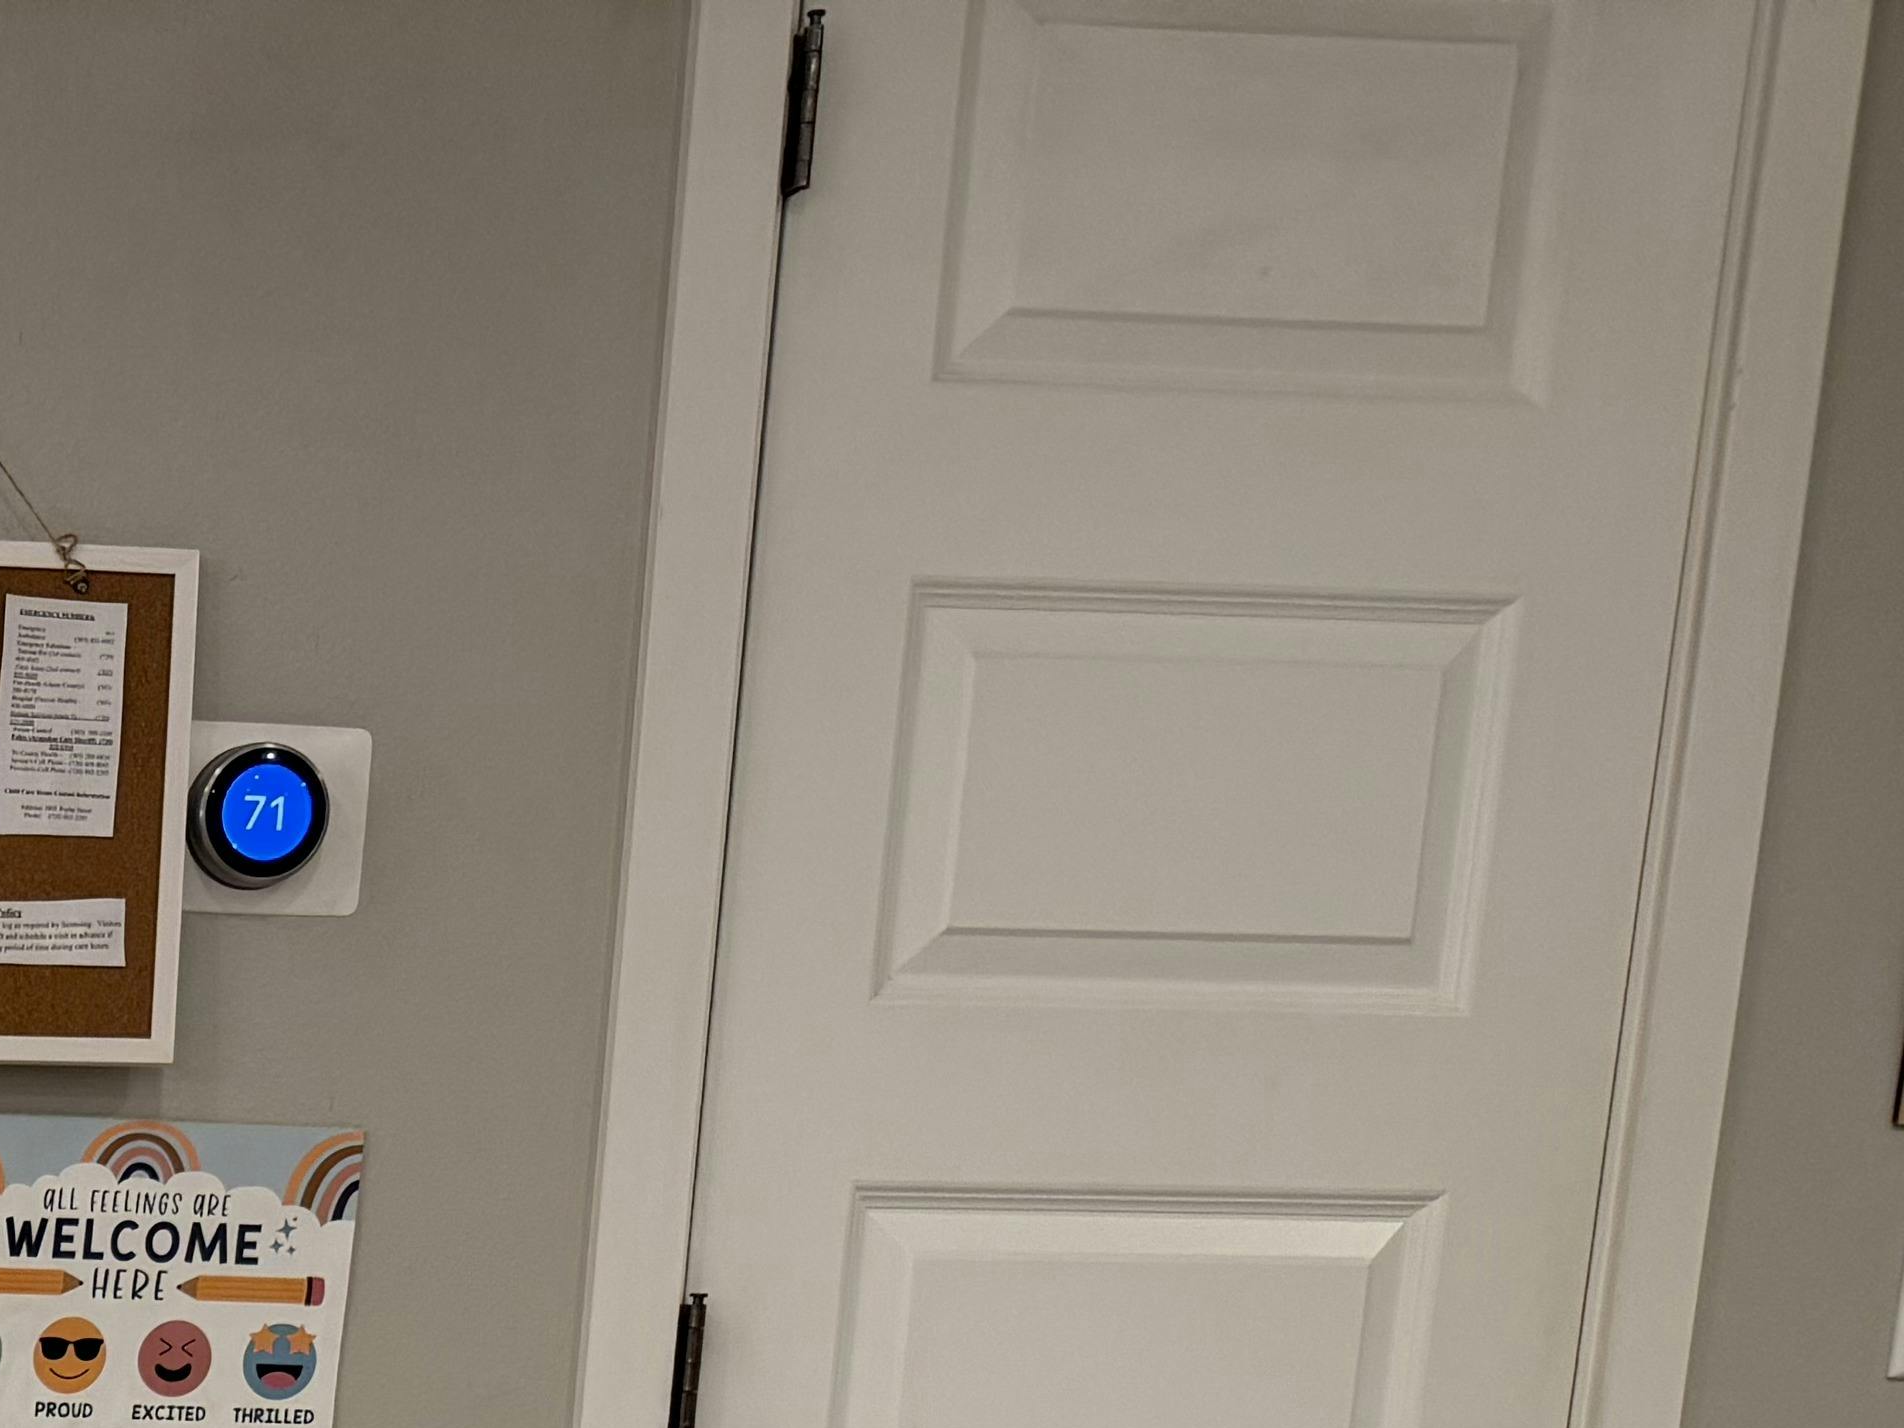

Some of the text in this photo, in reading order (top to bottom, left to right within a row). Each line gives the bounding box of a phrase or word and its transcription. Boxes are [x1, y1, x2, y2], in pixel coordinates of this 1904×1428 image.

[244, 795, 285, 831] 71
[91, 1190, 182, 1215] FEELINGS
[6, 1216, 262, 1265] WELCOME
[92, 1268, 168, 1300] HERE
[34, 1402, 93, 1419] PROUD
[132, 1404, 206, 1422] EXCITED
[233, 1408, 314, 1425] THRILLED
